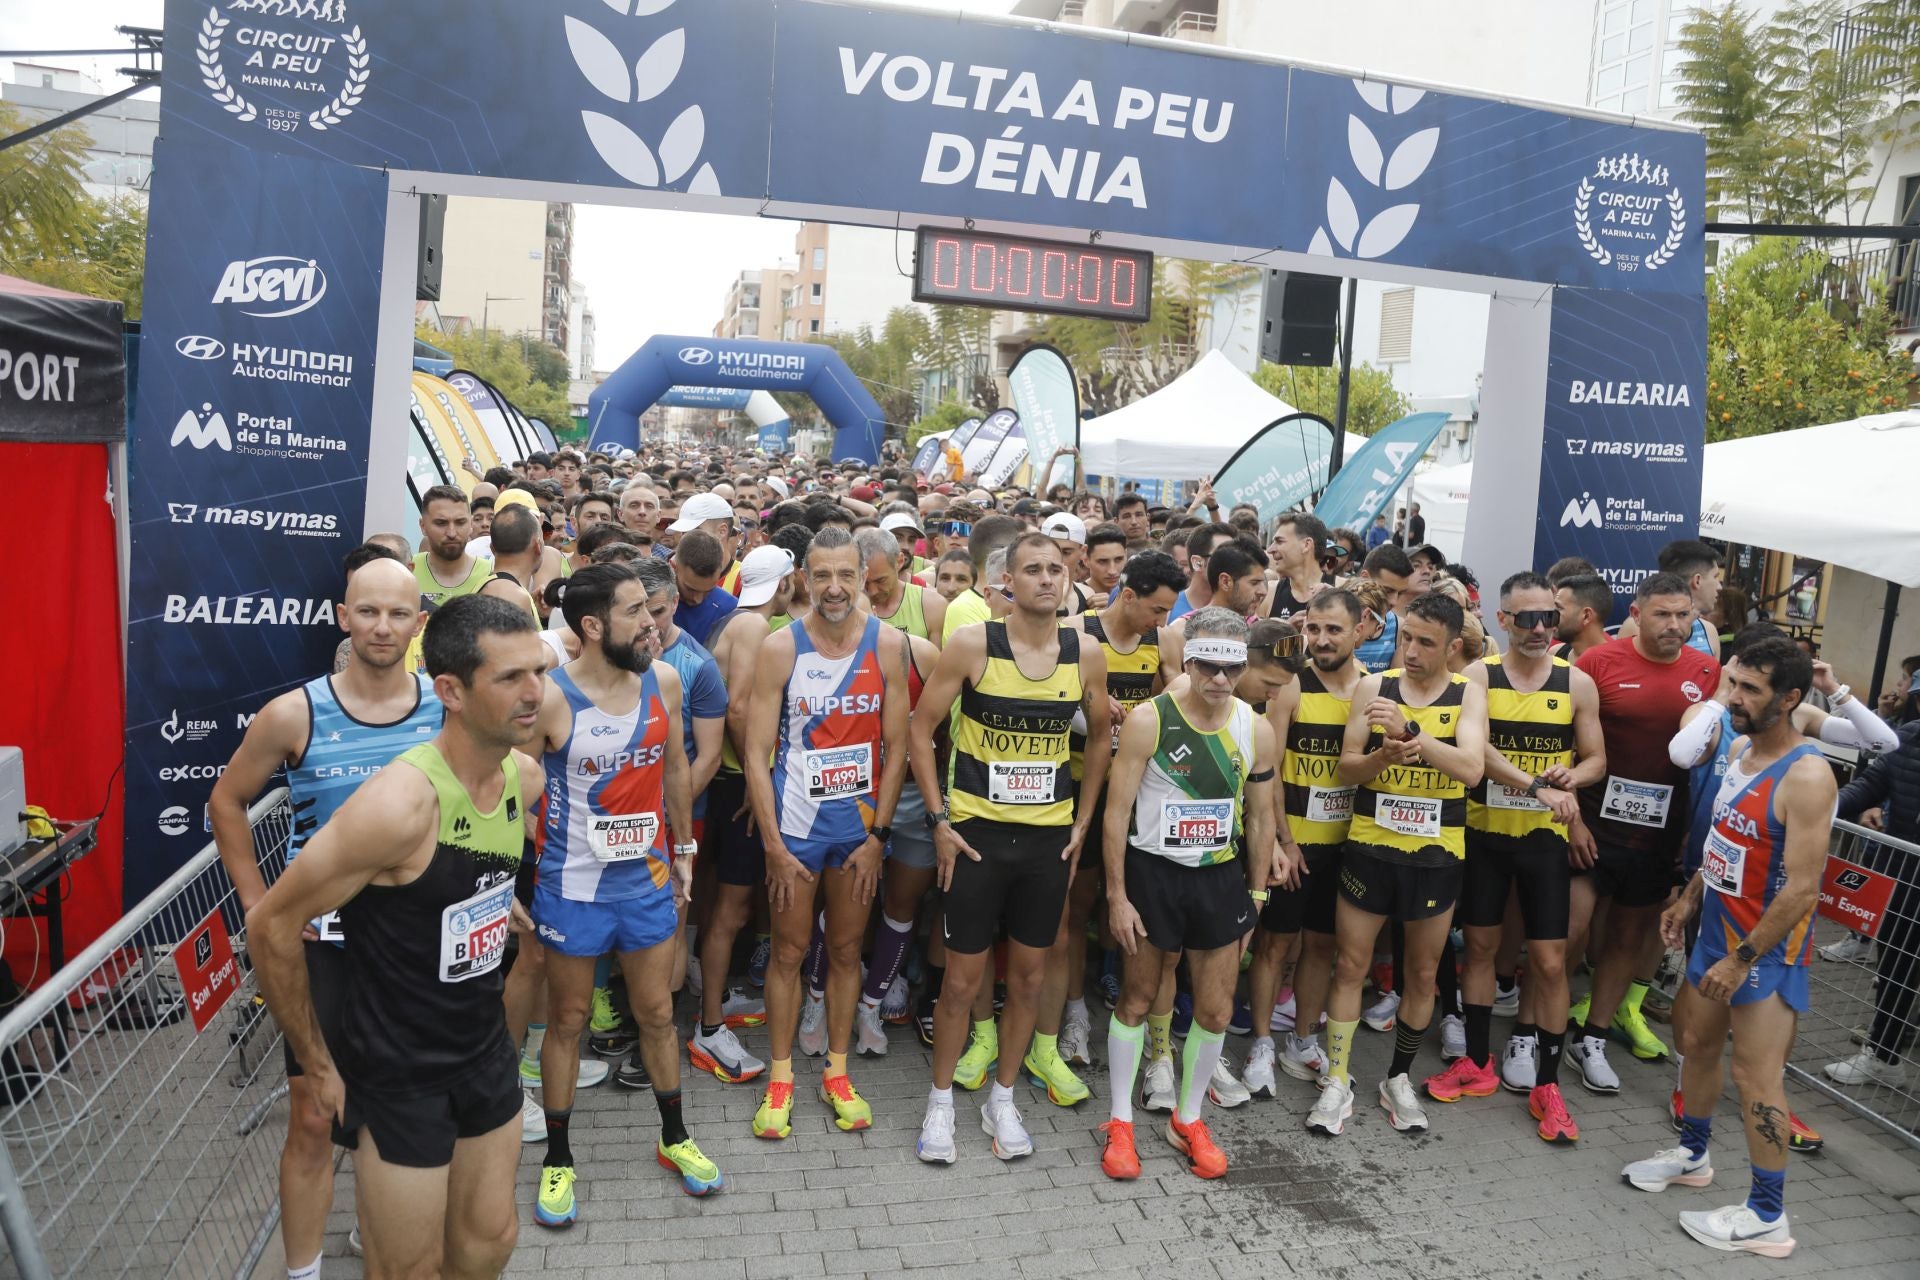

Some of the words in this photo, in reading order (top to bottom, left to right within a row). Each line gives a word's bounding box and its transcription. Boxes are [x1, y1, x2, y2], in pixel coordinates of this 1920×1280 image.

[236, 28, 336, 54] CIRCUIT
[245, 51, 263, 68] A
[271, 53, 322, 74] PEU
[242, 74, 290, 89] MARINA
[294, 81, 326, 93] ALTA
[838, 47, 1044, 118] VOLTA
[1052, 79, 1100, 126] A
[1113, 86, 1234, 143] PEU
[265, 109, 285, 118] DES
[287, 110, 300, 120] DE
[266, 118, 299, 131] 1997
[920, 126, 1148, 209] DÉNIA
[1598, 192, 1662, 210] CIRCUIT
[1604, 209, 1616, 222] A
[1620, 211, 1653, 226] PEU
[1601, 228, 1633, 238] MARINA
[1635, 231, 1656, 240] ALTA
[933, 239, 1136, 307] 00:00:00
[1617, 262, 1639, 271] 1997
[232, 342, 353, 374] HYUNDAI
[717, 350, 805, 370] HYUNDAI
[232, 362, 351, 387] Autoalmenar
[718, 365, 805, 381] Autoalmenar
[716, 388, 736, 396] PEU
[1569, 380, 1691, 407] BALEARIA
[237, 412, 292, 431] Portal
[236, 428, 259, 443] de
[265, 431, 281, 445] la
[287, 433, 347, 451] Marina
[1591, 440, 1685, 458] masymas
[1279, 454, 1331, 488] Marina
[1232, 466, 1281, 503] Portal
[1606, 498, 1645, 509] Portal
[204, 507, 337, 531] masymas
[1605, 510, 1621, 521] de
[1625, 510, 1636, 521] la
[1640, 510, 1684, 523] Marina
[284, 529, 341, 538] SUPERMERCATS
[163, 594, 335, 625] BALEARIA
[794, 694, 880, 716] ALPESA
[186, 720, 218, 730] REMA
[1523, 736, 1563, 750] VESPA
[812, 775, 820, 786] D
[824, 768, 857, 784] 1499
[1008, 775, 1041, 789] 3708
[824, 783, 858, 794] BALEARIA
[1324, 798, 1349, 811] 3696
[1413, 802, 1437, 811] ESPORT
[1611, 798, 1619, 808] C
[1625, 800, 1648, 813] 995
[158, 817, 189, 825] CANFALI
[613, 820, 630, 829] SOM
[630, 818, 654, 827] ESPORT
[1392, 808, 1425, 822] 3707
[608, 828, 642, 845] 3701
[1170, 825, 1176, 836] E
[1182, 824, 1215, 837] 1485
[455, 943, 466, 960] B
[471, 924, 507, 957] 1500
